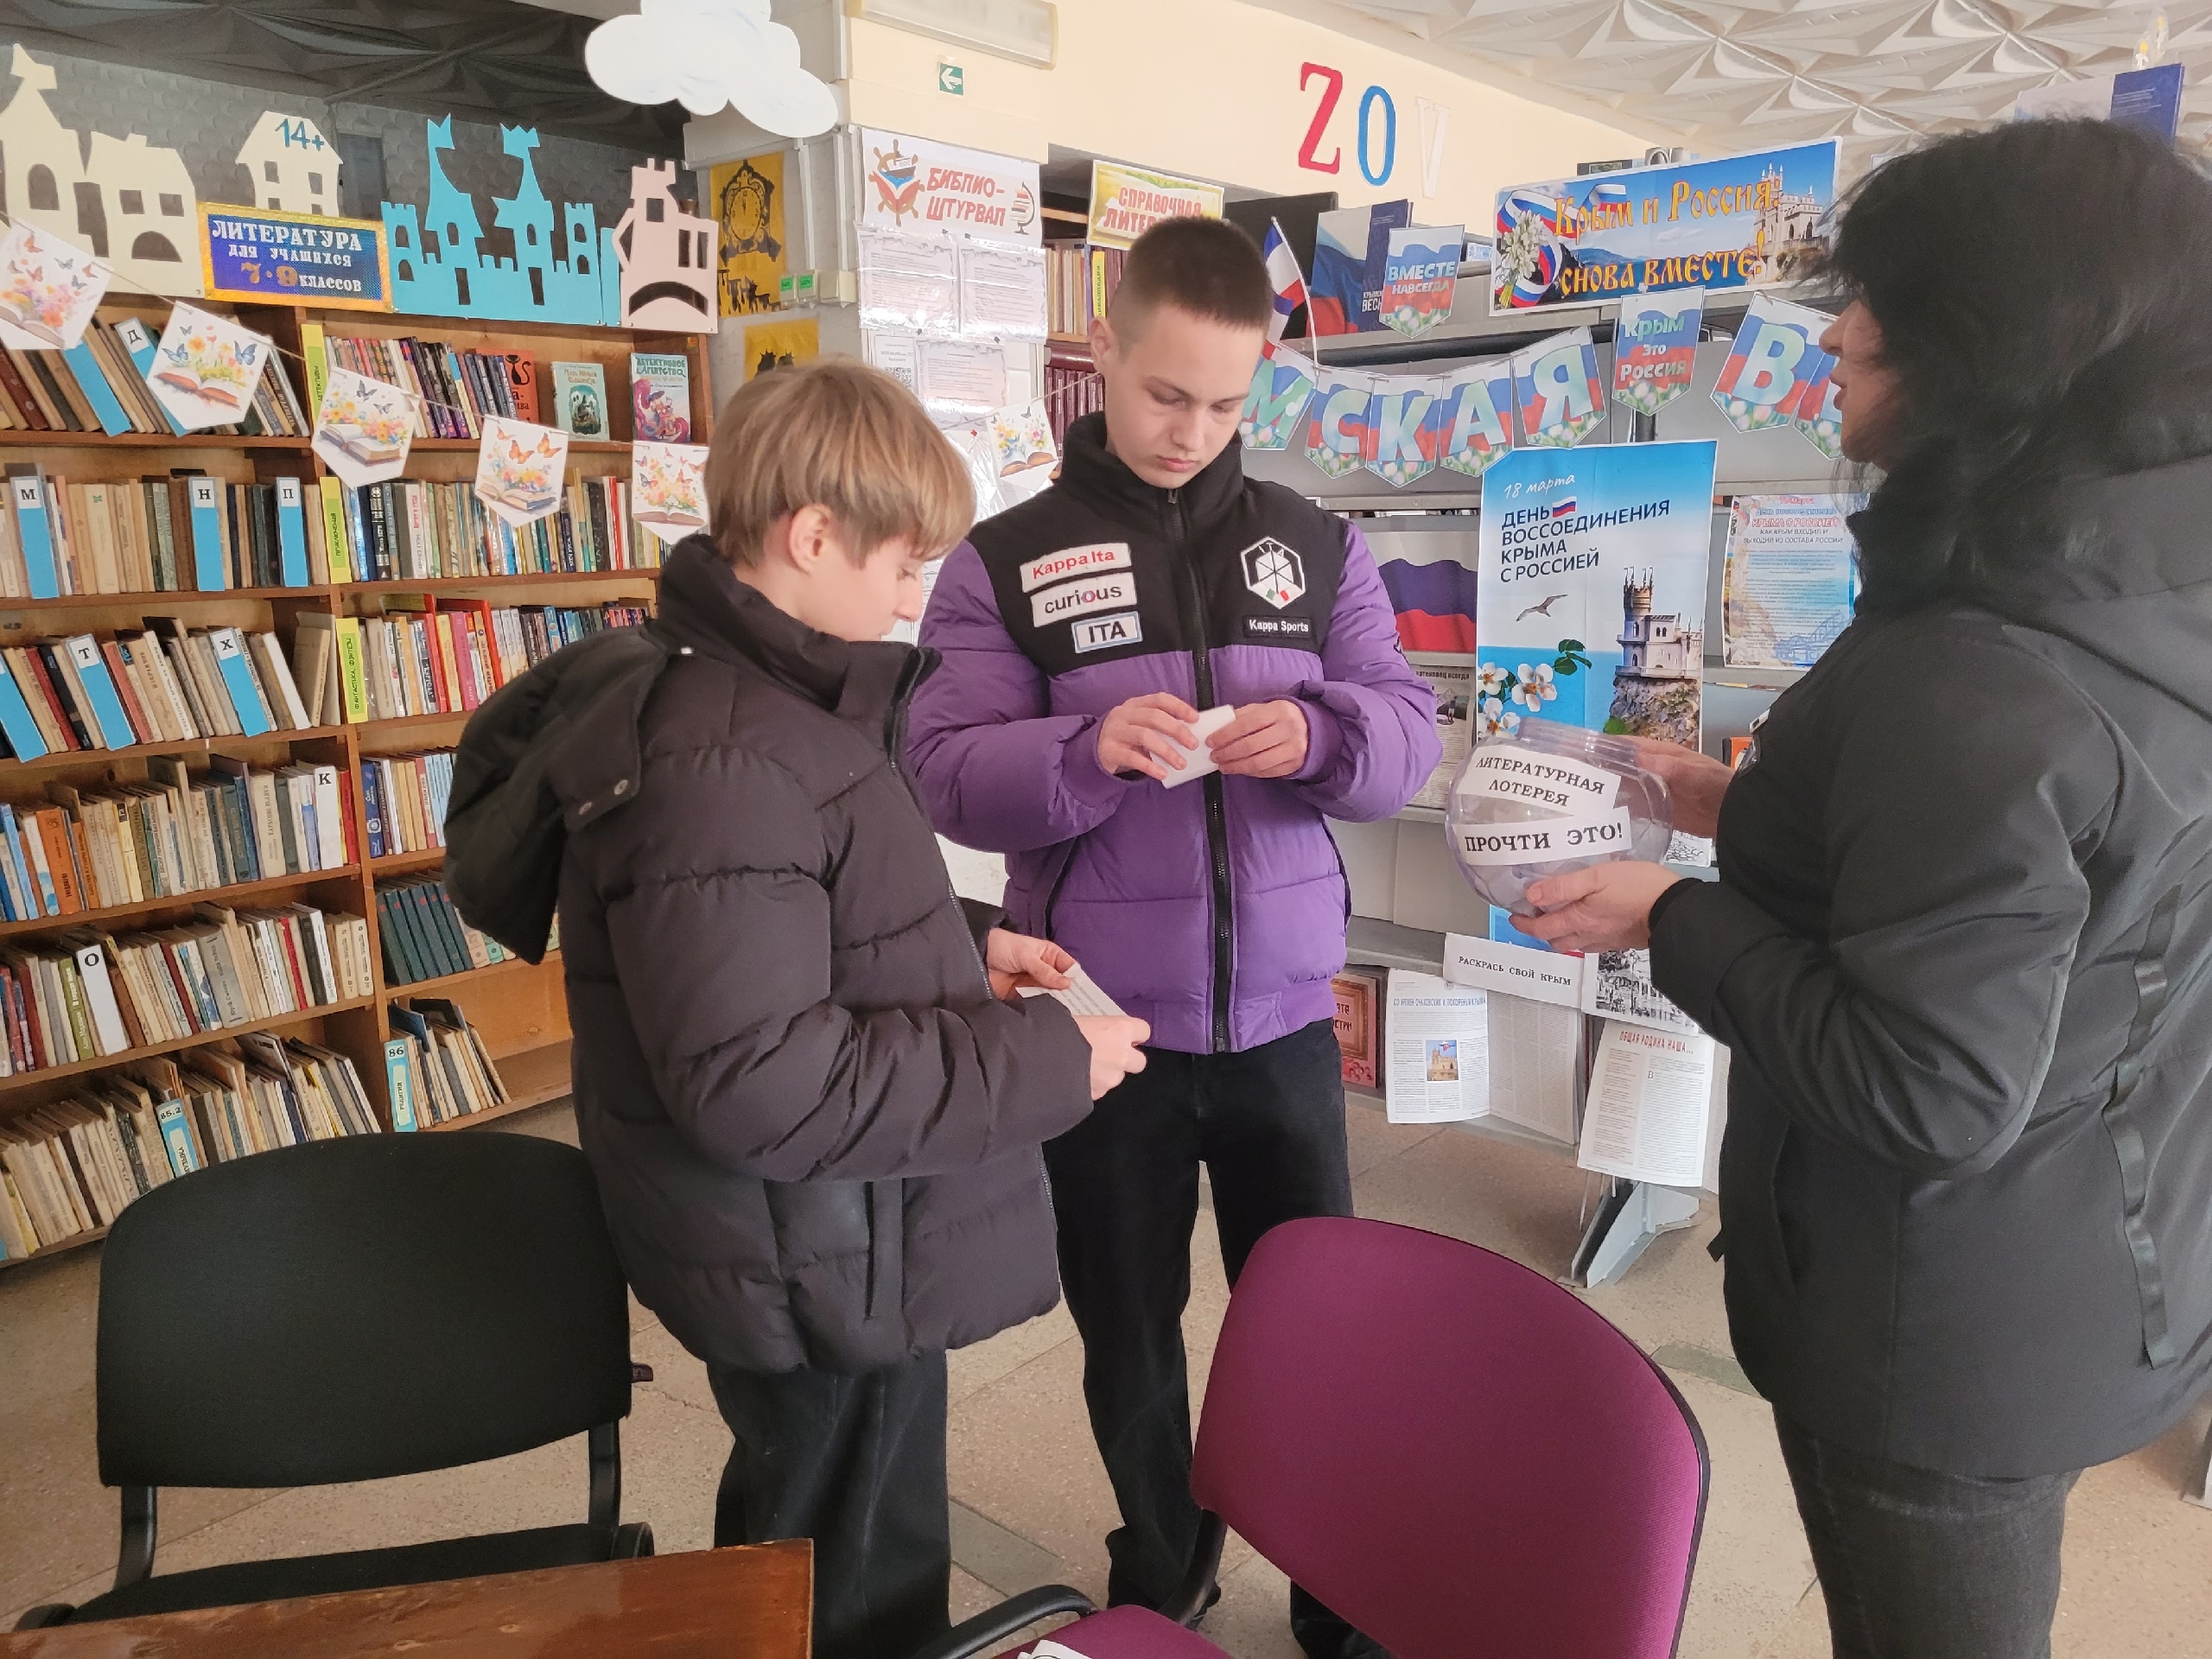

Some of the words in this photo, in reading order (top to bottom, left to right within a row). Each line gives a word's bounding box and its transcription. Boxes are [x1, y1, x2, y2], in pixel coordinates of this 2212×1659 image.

[275, 118, 325, 150] 14+
[926, 167, 1005, 198] БИБЛИО-
[926, 196, 1007, 226] ШТУРВАЛ
[1118, 187, 1202, 216] СПРАВОЧНАЯ
[1553, 195, 1634, 245] Крым
[1643, 197, 1658, 225] и
[212, 219, 363, 251] ЛИТЕРАТУРА
[229, 244, 258, 258] ДЛЯ
[1560, 263, 1634, 298] снова
[1643, 228, 1764, 286] вместе!
[299, 275, 362, 292] КЛАССОВ
[1387, 261, 1455, 282] ВМЕСТЕ
[1392, 281, 1449, 295] НАВСЕГДА
[129, 328, 142, 346] Д
[21, 487, 37, 501] М
[198, 488, 212, 500] Н
[283, 488, 294, 499] П
[1503, 482, 1522, 499] 18
[1526, 474, 1575, 494] марта
[1502, 505, 1550, 531] ДЕНЬ
[1502, 499, 1670, 546] ВОССОЕДИНЕНИЯ
[1752, 518, 1784, 527] КРЫМА
[1786, 518, 1793, 527] С
[1794, 517, 1838, 527] РОССИЕЙ
[332, 512, 341, 556] ПРИКЛЮЧЕНИЯ
[1501, 538, 1567, 565] КРЫМА
[1500, 568, 1511, 583] С
[1516, 548, 1600, 581] РОССИЕЙ
[1044, 586, 1122, 614] curious
[1088, 620, 1128, 644] ITA
[1249, 619, 1279, 632] Kappa
[1281, 620, 1309, 633] Sports
[79, 646, 90, 659] Т
[220, 638, 233, 651] Х
[319, 772, 331, 785] К
[1476, 756, 1605, 795] ЛИТЕРАТУРНАЯ
[1489, 779, 1569, 807] ЛОТЕРЕЯ
[1465, 833, 1550, 852] ПРОЧТИ
[1567, 822, 1623, 845] ЭТО!
[84, 953, 99, 968] О
[1459, 956, 1504, 973] РАСКРАСЬ
[1509, 965, 1535, 979] СВОЙ
[1541, 973, 1571, 986] КРЫМ
[388, 1046, 404, 1058] 86
[1619, 1031, 1640, 1044] ОБЩАЯ
[1640, 1034, 1665, 1049] РОДИНА
[160, 1106, 181, 1120] 85.2
